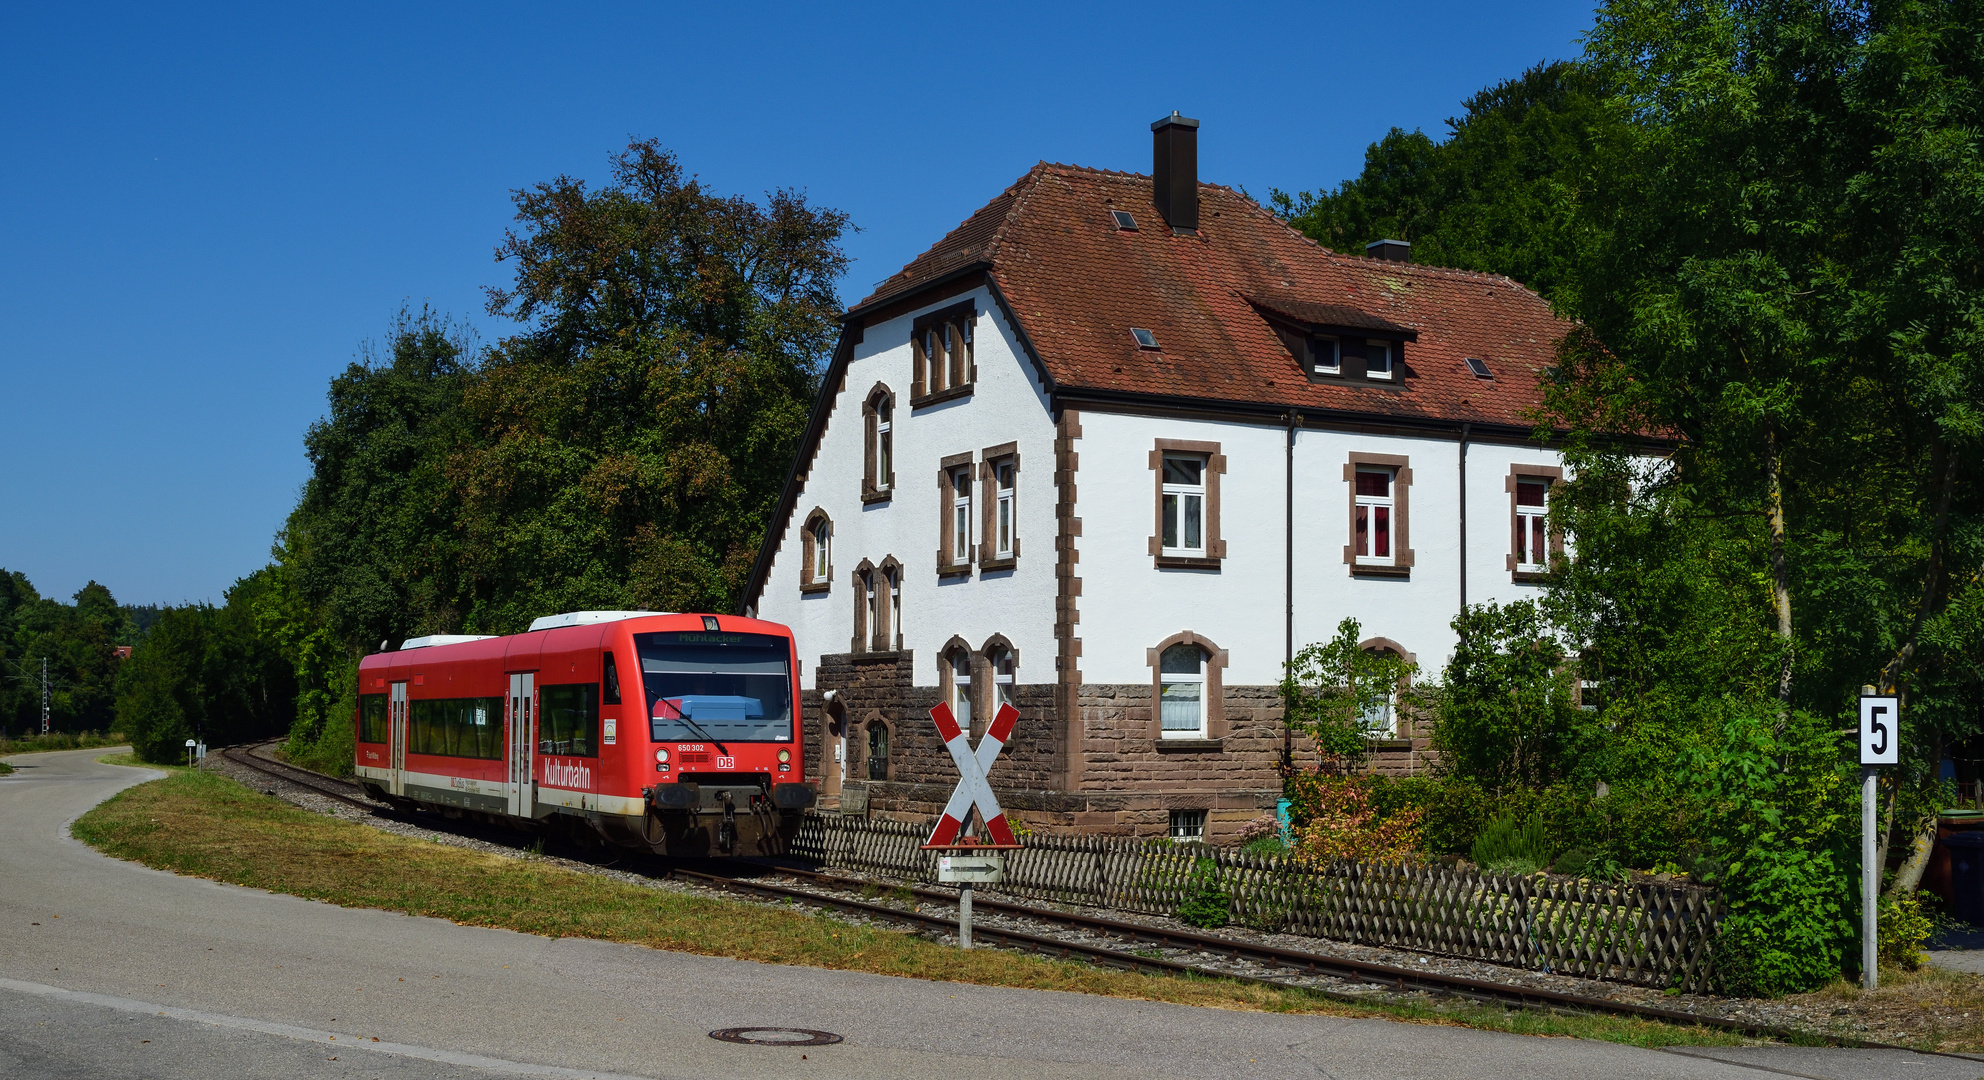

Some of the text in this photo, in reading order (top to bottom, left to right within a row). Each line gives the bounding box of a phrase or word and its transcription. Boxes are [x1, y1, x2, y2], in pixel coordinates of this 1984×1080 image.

[678, 633, 743, 643] Mühlacker
[505, 691, 509, 707] 2
[534, 689, 538, 706] 2
[1871, 706, 1887, 755] 5
[677, 744, 704, 752] 650 302
[718, 757, 734, 768] DB
[544, 757, 591, 789] Kulturbahn
